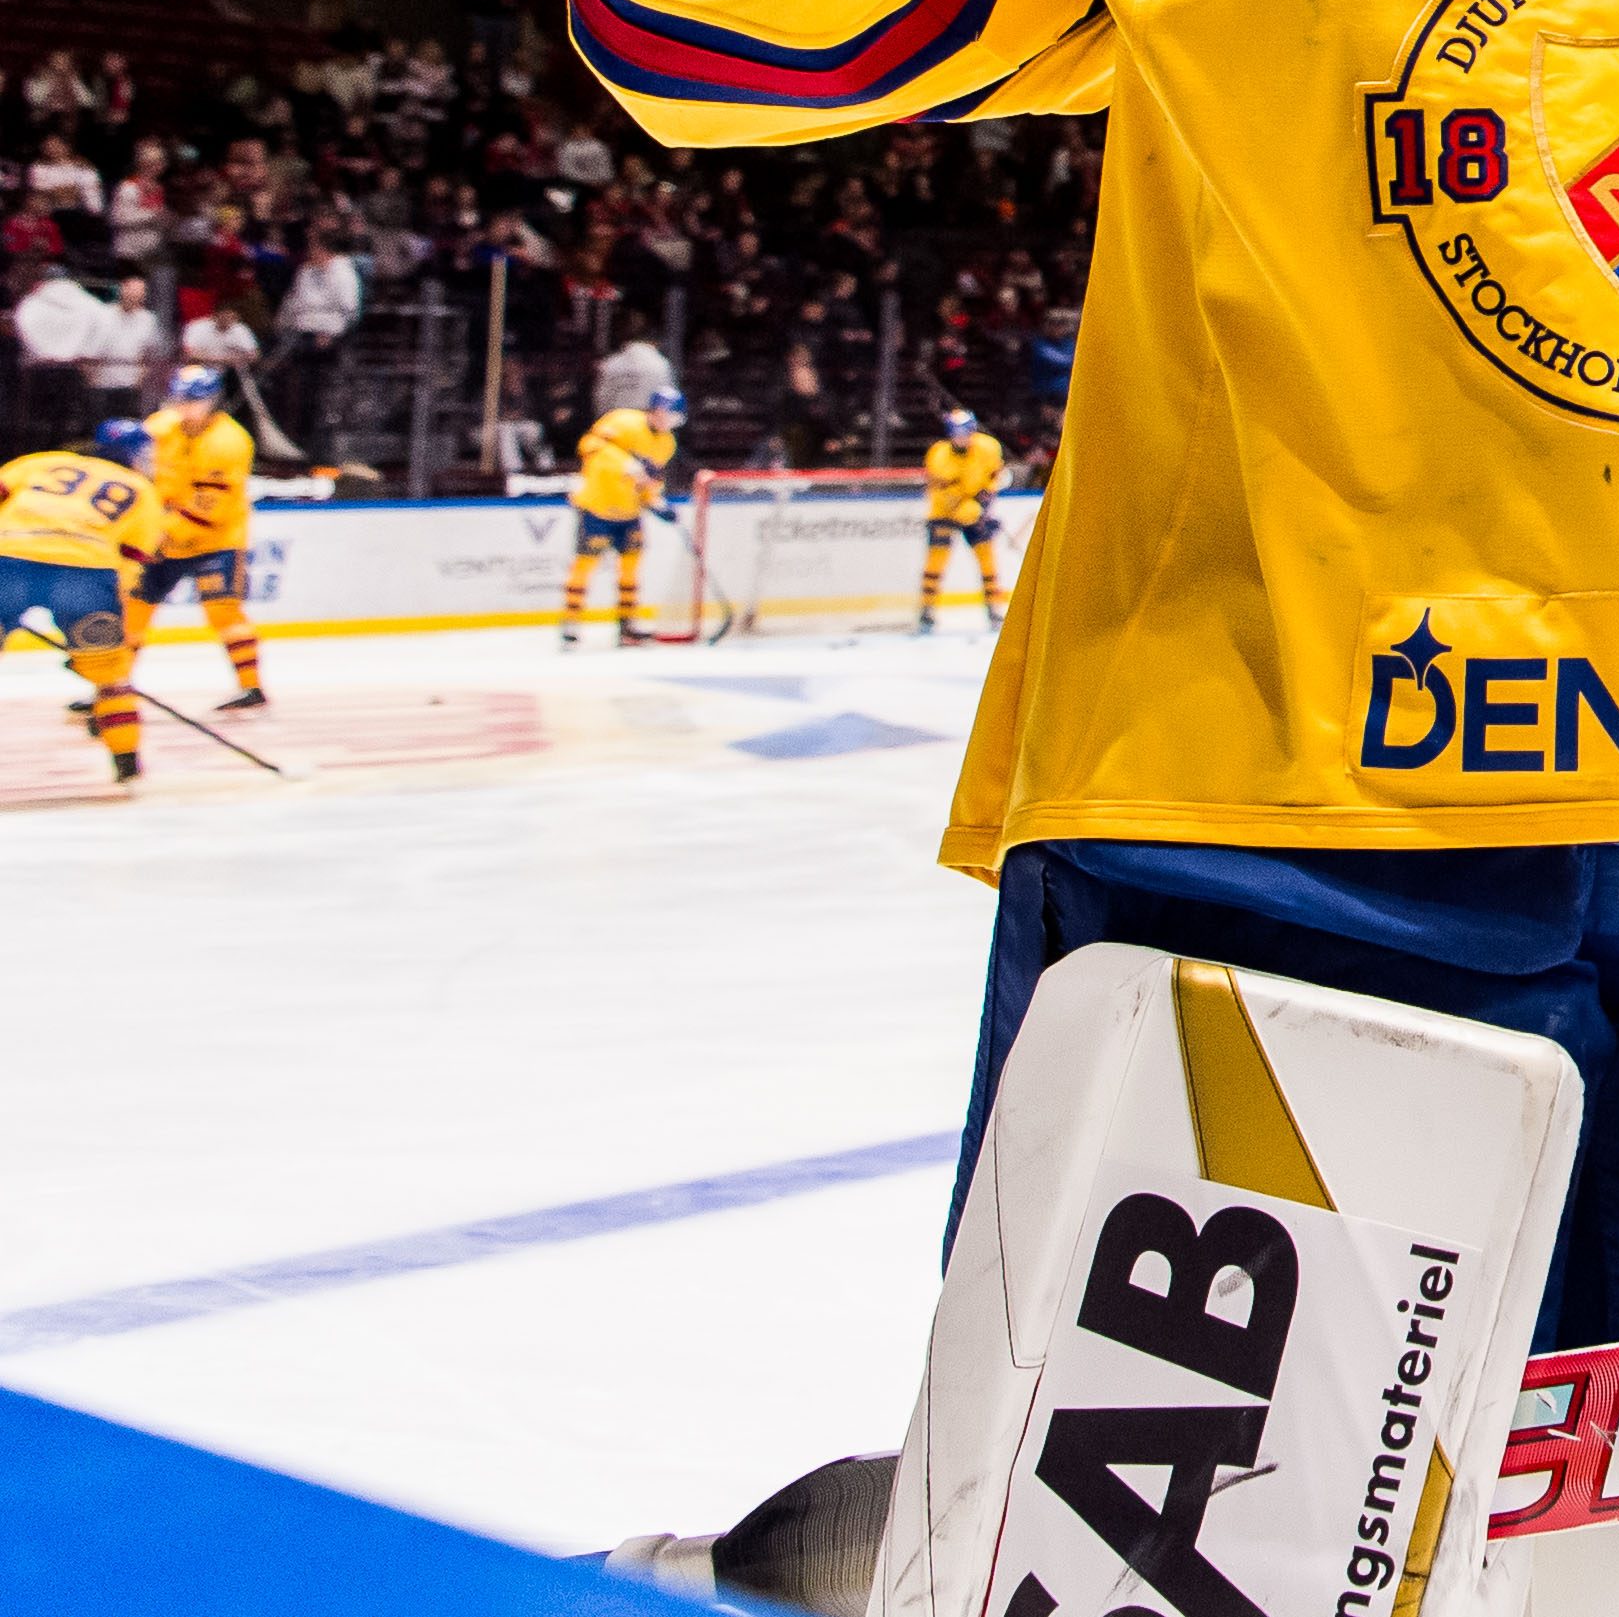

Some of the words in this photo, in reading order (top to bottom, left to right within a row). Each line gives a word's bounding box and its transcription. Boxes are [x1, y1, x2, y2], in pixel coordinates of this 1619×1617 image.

[1384, 107, 1510, 205] 18
[32, 466, 138, 522] 38
[1335, 1241, 1461, 1617] ngsmateriel
